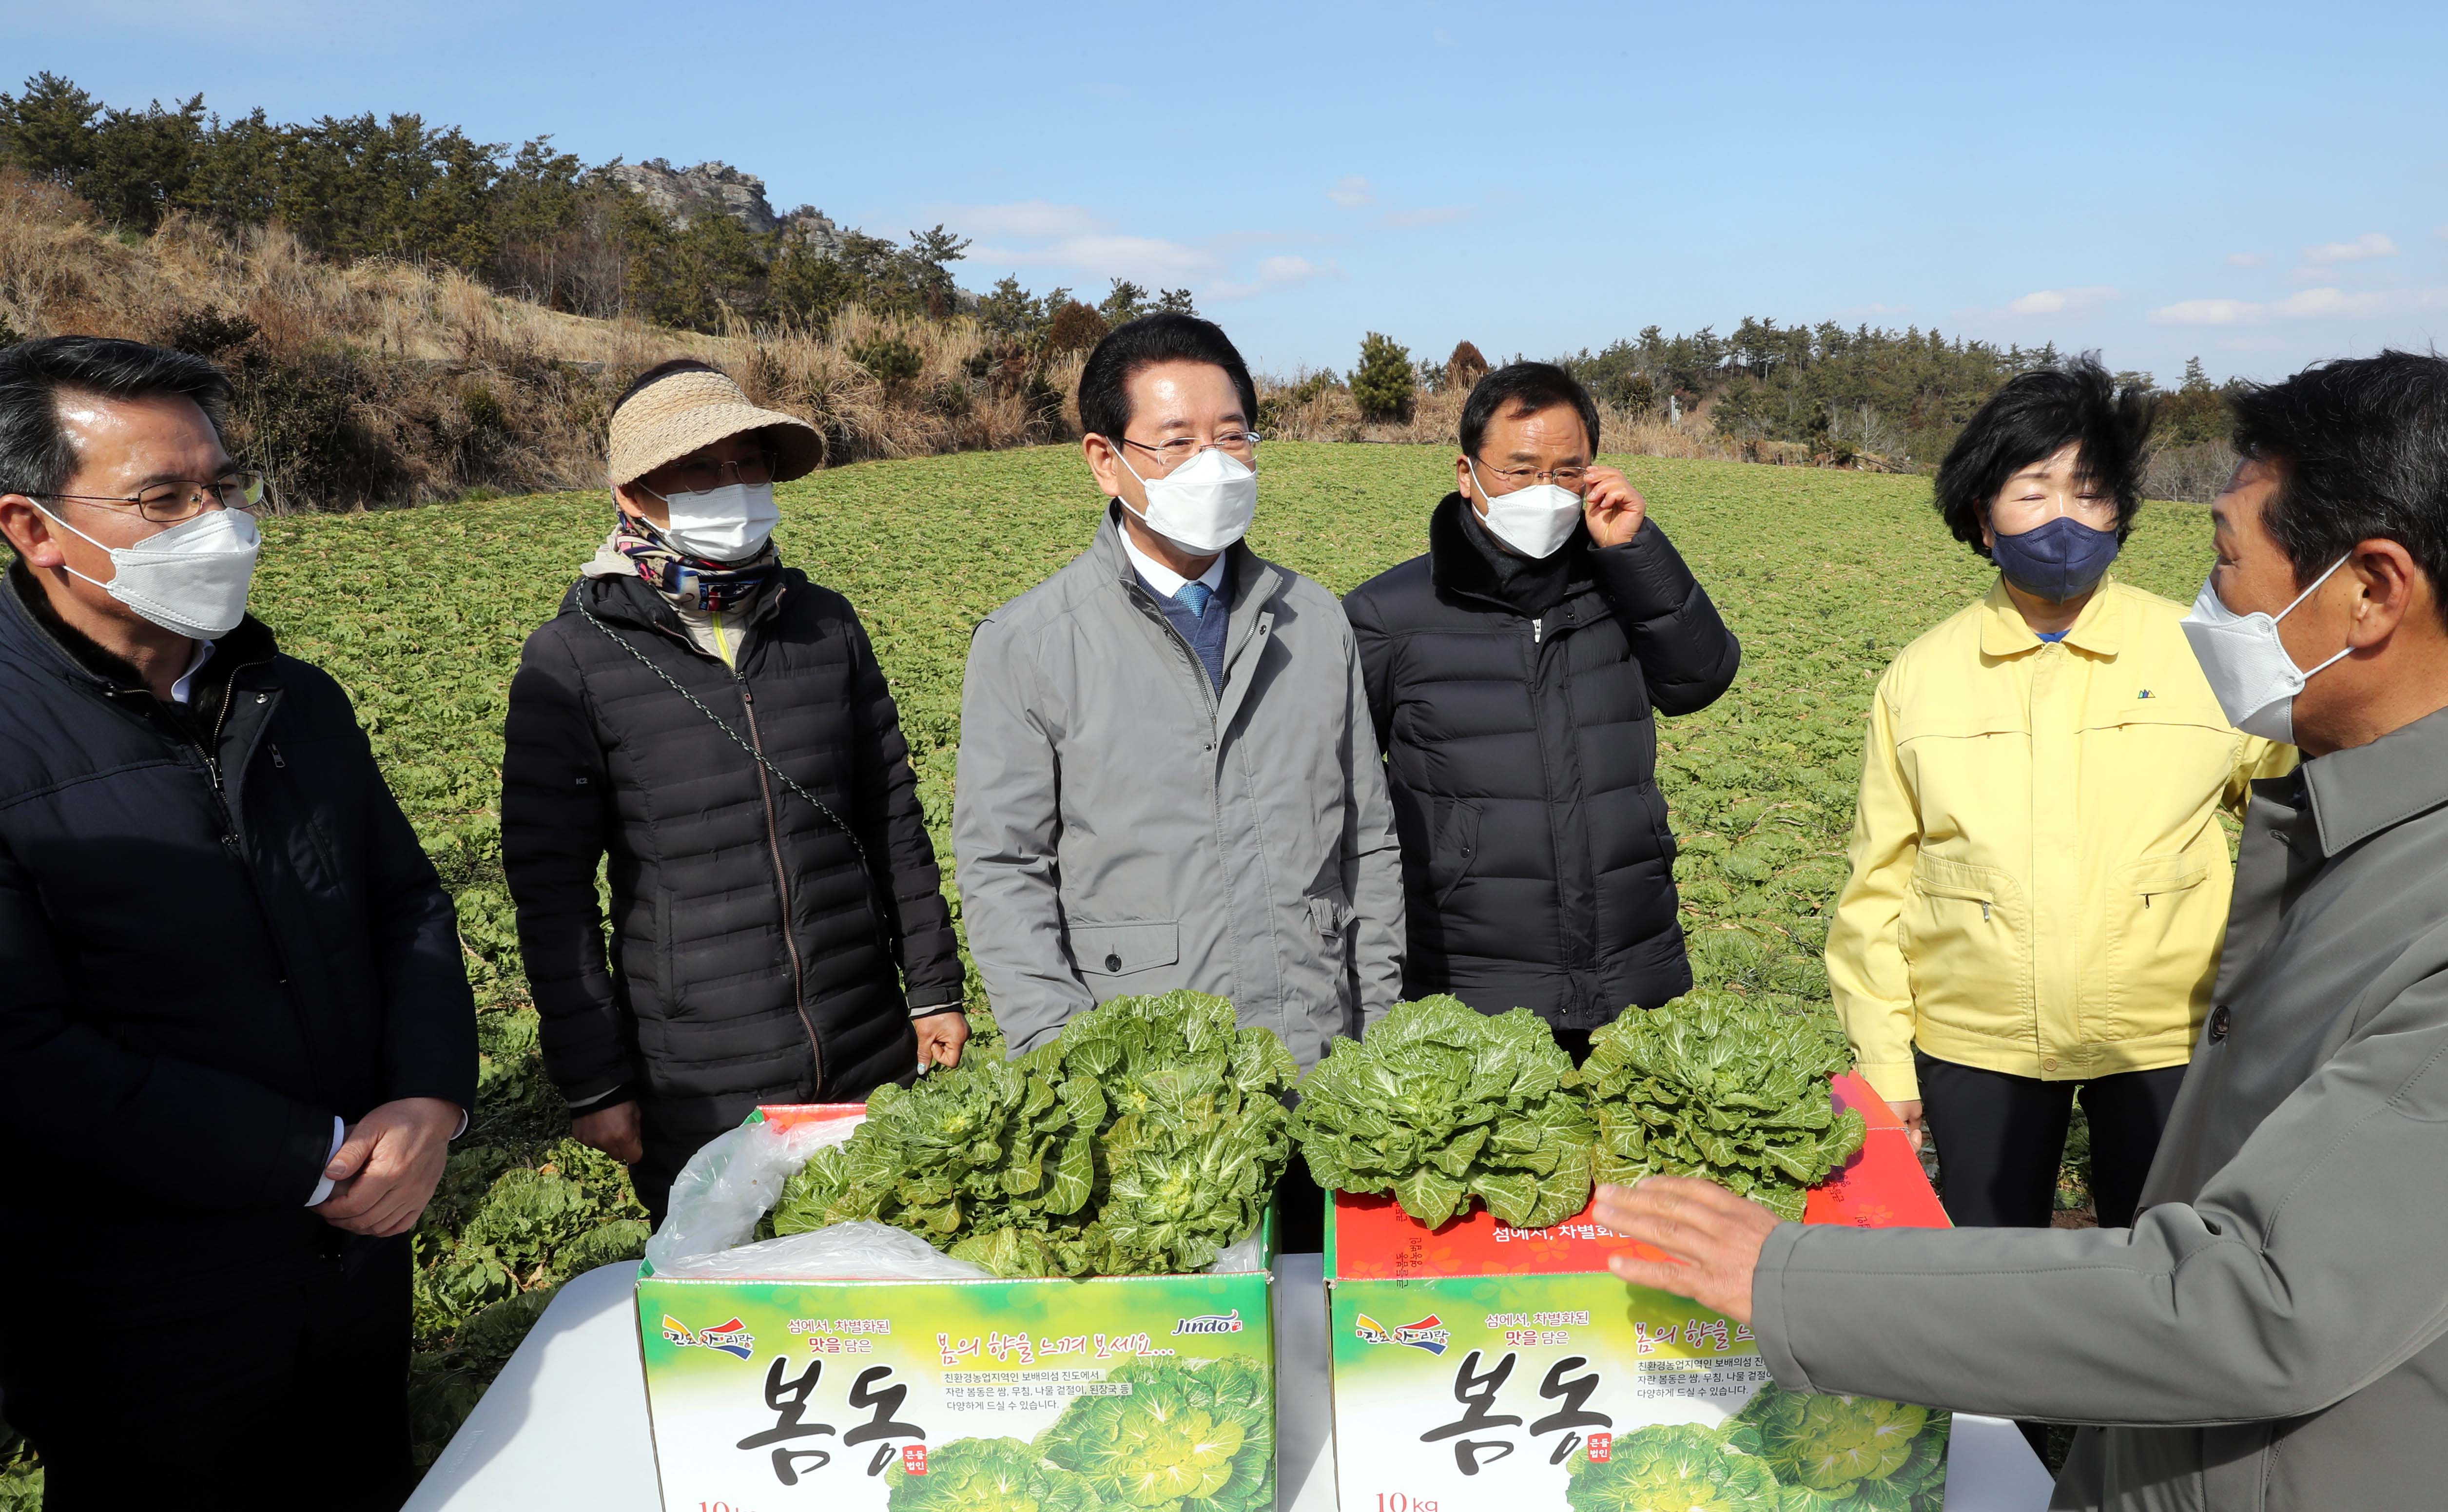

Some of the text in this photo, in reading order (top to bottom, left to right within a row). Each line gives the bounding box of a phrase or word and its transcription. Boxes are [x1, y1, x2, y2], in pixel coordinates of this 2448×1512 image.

[1558, 1224, 1631, 1240] 차별화
[1486, 1311, 1588, 1327] 섬에서, 차별화된
[788, 1320, 890, 1333] 섬에서, 차별화된
[1172, 1319, 1230, 1335] Jindo
[1506, 1331, 1569, 1346] 맛을 담은
[1636, 1320, 1754, 1353] 봄의 향을 느
[809, 1338, 872, 1353] 맛을 담은
[938, 1333, 1173, 1364] 봄의 향을 느껴 보세요...
[1638, 1359, 1712, 1371] 친환경농업지역인
[1715, 1357, 1751, 1368] 보배의섬
[944, 1371, 1099, 1383] 친환경농업지역인 보배의섬 진도에서
[1637, 1375, 1655, 1385] 자란
[1658, 1374, 1686, 1384] 봄동은
[1689, 1373, 1700, 1383] 쌈,
[1703, 1372, 1724, 1383] 무침,
[1727, 1371, 1745, 1381] 나물
[946, 1384, 1129, 1397] 자란 봄동은 쌈, 무침, 나물 겉절이, 된장국 등
[1637, 1386, 1749, 1398] 다양하게 드실 수 있습니다.
[947, 1400, 1059, 1411] 다양하게 드실 수 있습니다.
[1419, 1351, 1613, 1475] 봄동
[736, 1357, 926, 1486] 봄동
[1590, 1438, 1610, 1448] 큰들
[905, 1450, 925, 1460] 큰들
[1590, 1449, 1608, 1458] 법인
[906, 1461, 925, 1471] 법인
[1376, 1493, 1407, 1512] 10
